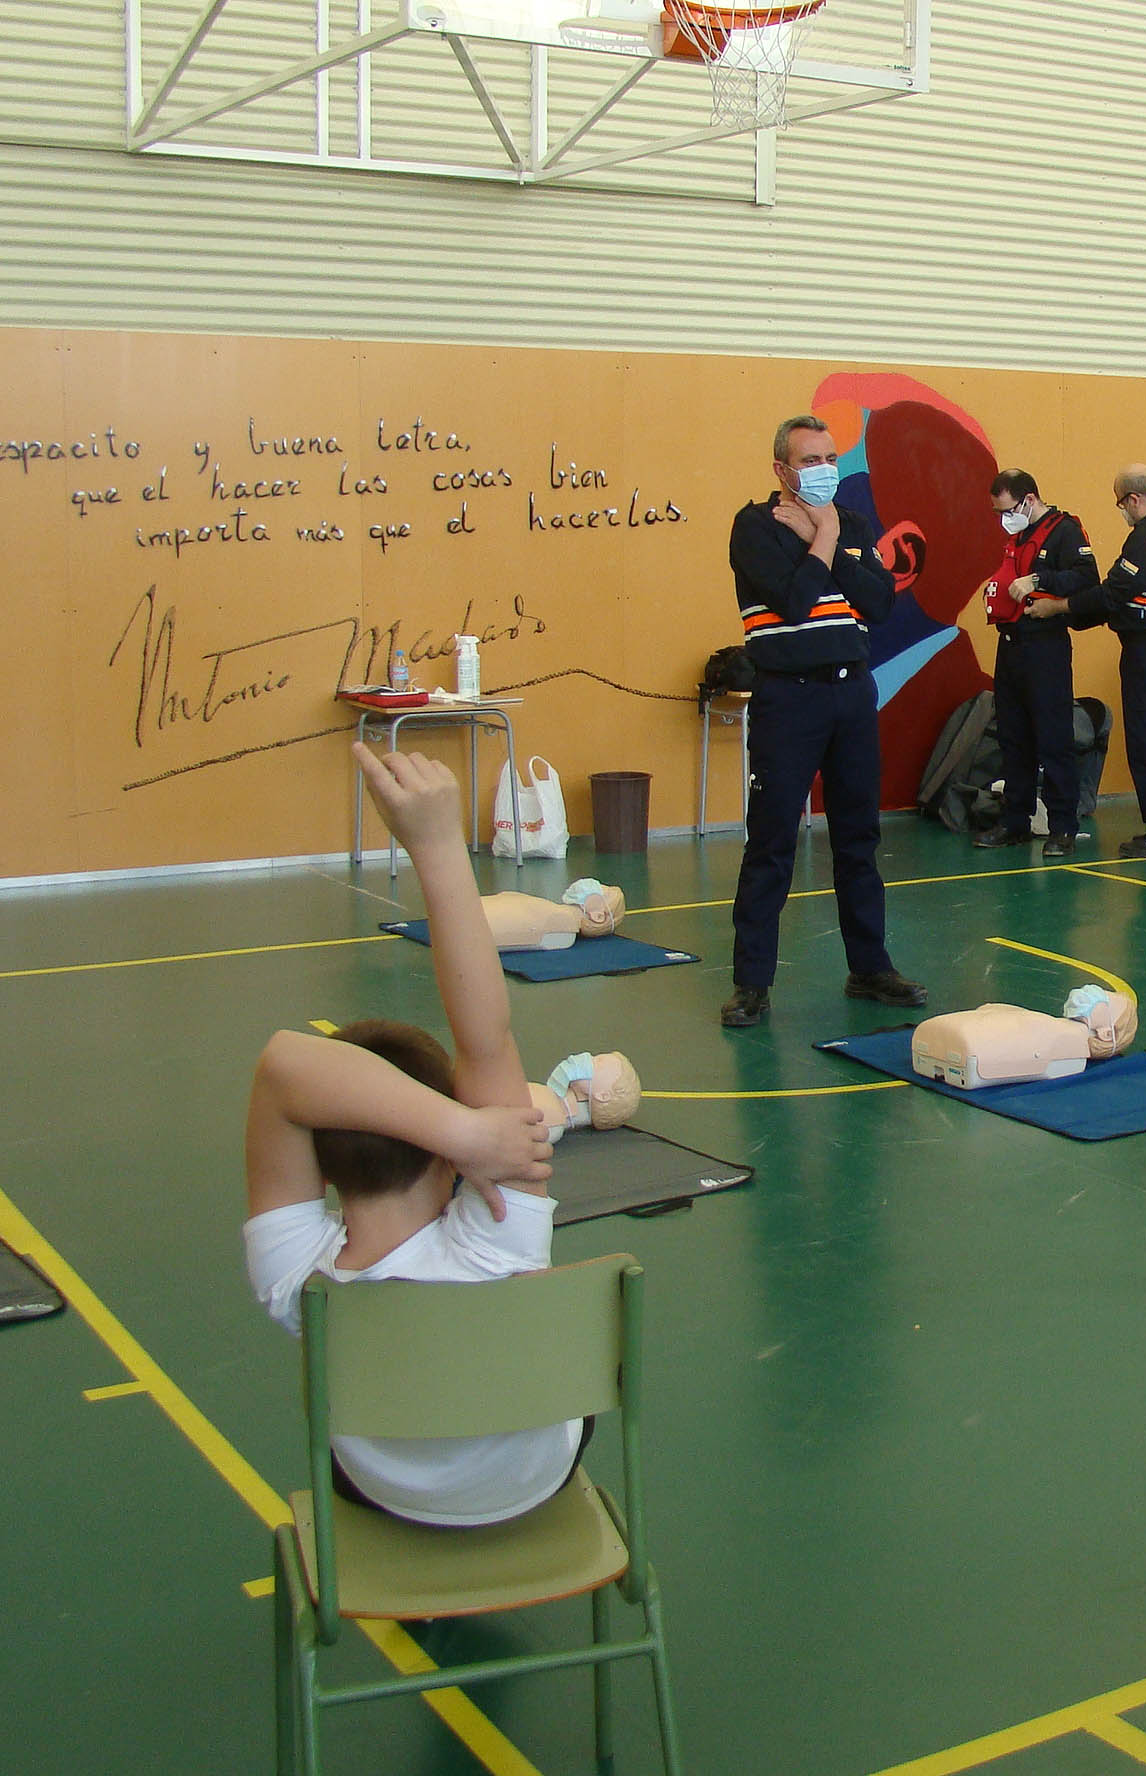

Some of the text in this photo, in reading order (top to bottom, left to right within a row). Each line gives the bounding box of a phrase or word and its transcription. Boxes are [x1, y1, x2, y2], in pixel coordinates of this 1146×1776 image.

[194, 441, 210, 475] y
[249, 416, 344, 456] buena
[71, 440, 609, 518] que el hacer las cosas bien
[135, 506, 272, 559] importa
[369, 522, 411, 554] que
[446, 500, 477, 534] el
